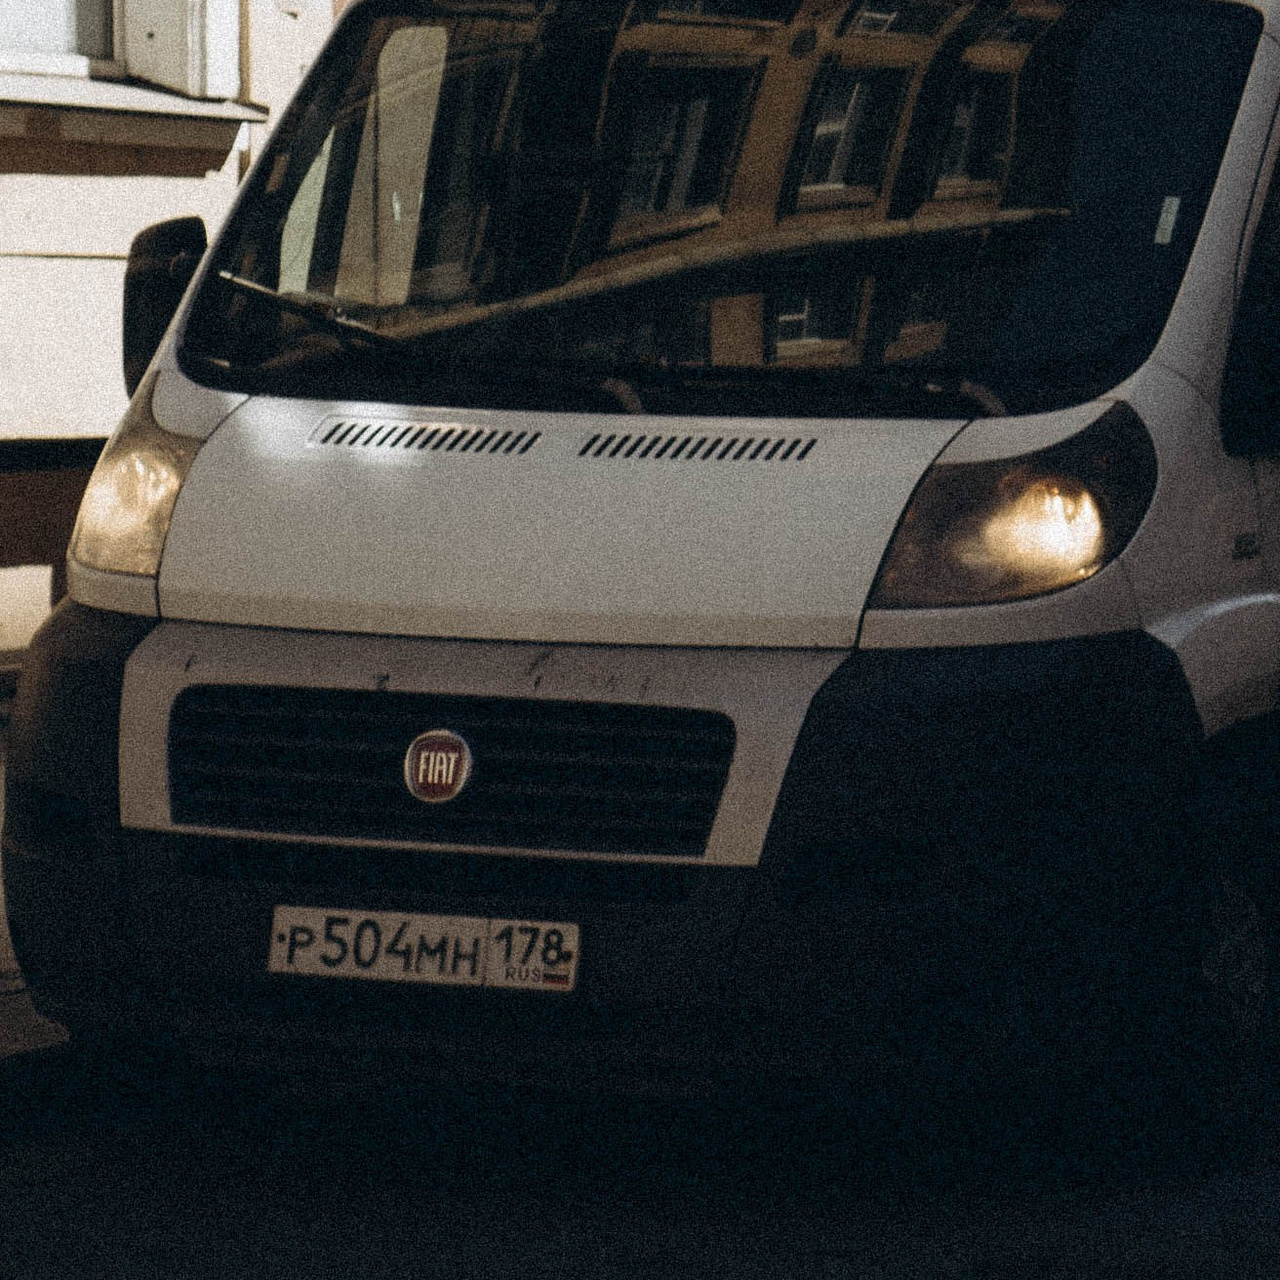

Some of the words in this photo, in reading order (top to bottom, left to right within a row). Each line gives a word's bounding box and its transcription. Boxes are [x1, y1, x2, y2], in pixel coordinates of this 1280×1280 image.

[418, 750, 459, 784] FIAT
[495, 925, 565, 966] 178
[504, 966, 542, 982] RUS
